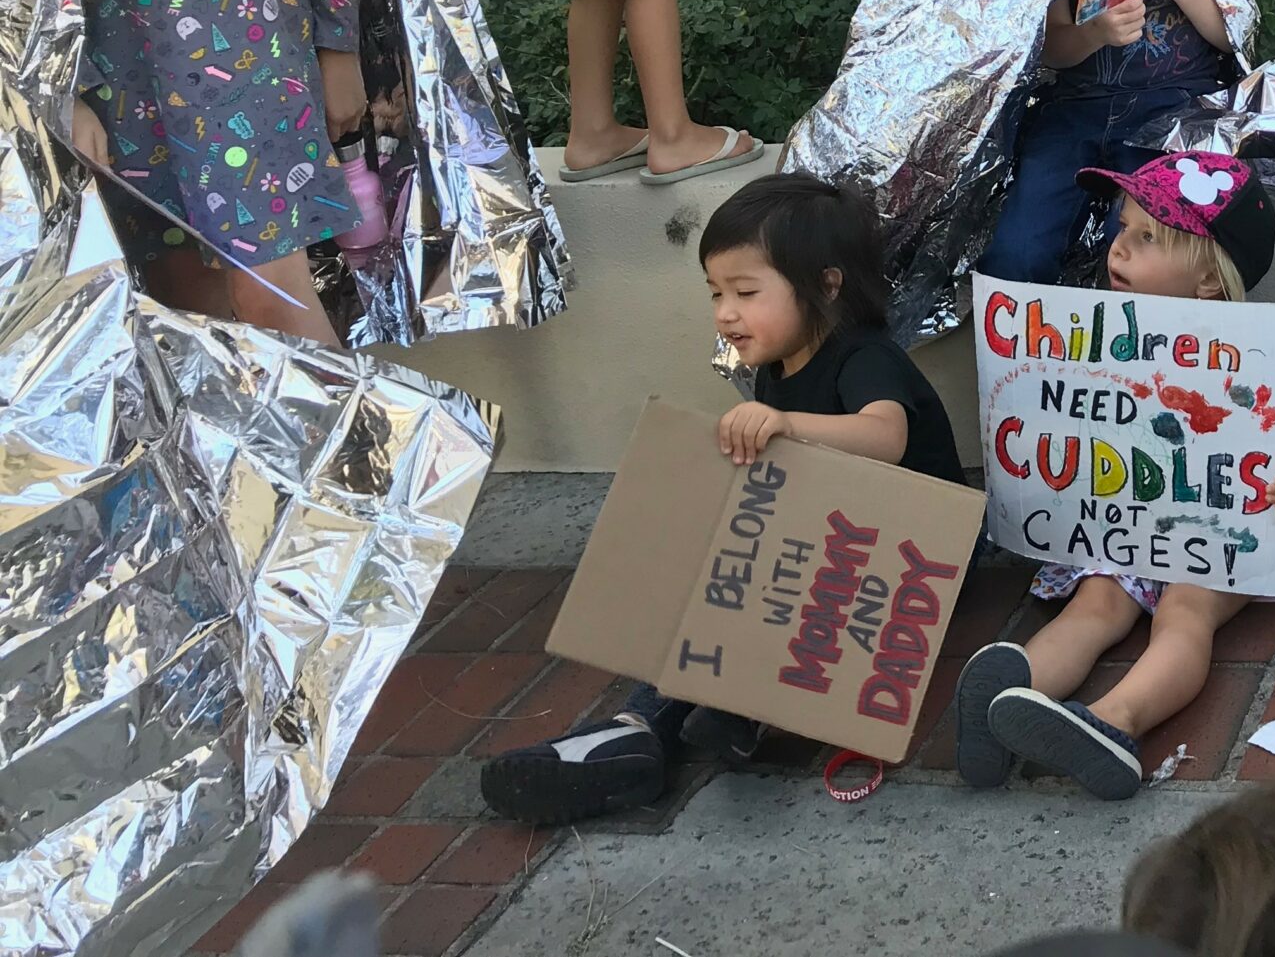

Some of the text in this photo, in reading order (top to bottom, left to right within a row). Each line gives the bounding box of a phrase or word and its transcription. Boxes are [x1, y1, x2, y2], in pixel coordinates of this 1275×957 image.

[289, 166, 310, 187] Hi!
[984, 291, 1241, 372] Children
[1041, 380, 1138, 425] NEED
[995, 416, 1273, 515] CUDDLES
[1023, 509, 1237, 586] CAGES!
[1080, 498, 1147, 526] NOT
[678, 460, 788, 677] I BELONG
[778, 509, 879, 694] MOMMY
[845, 573, 890, 654] AND
[857, 539, 959, 726] DADDY
